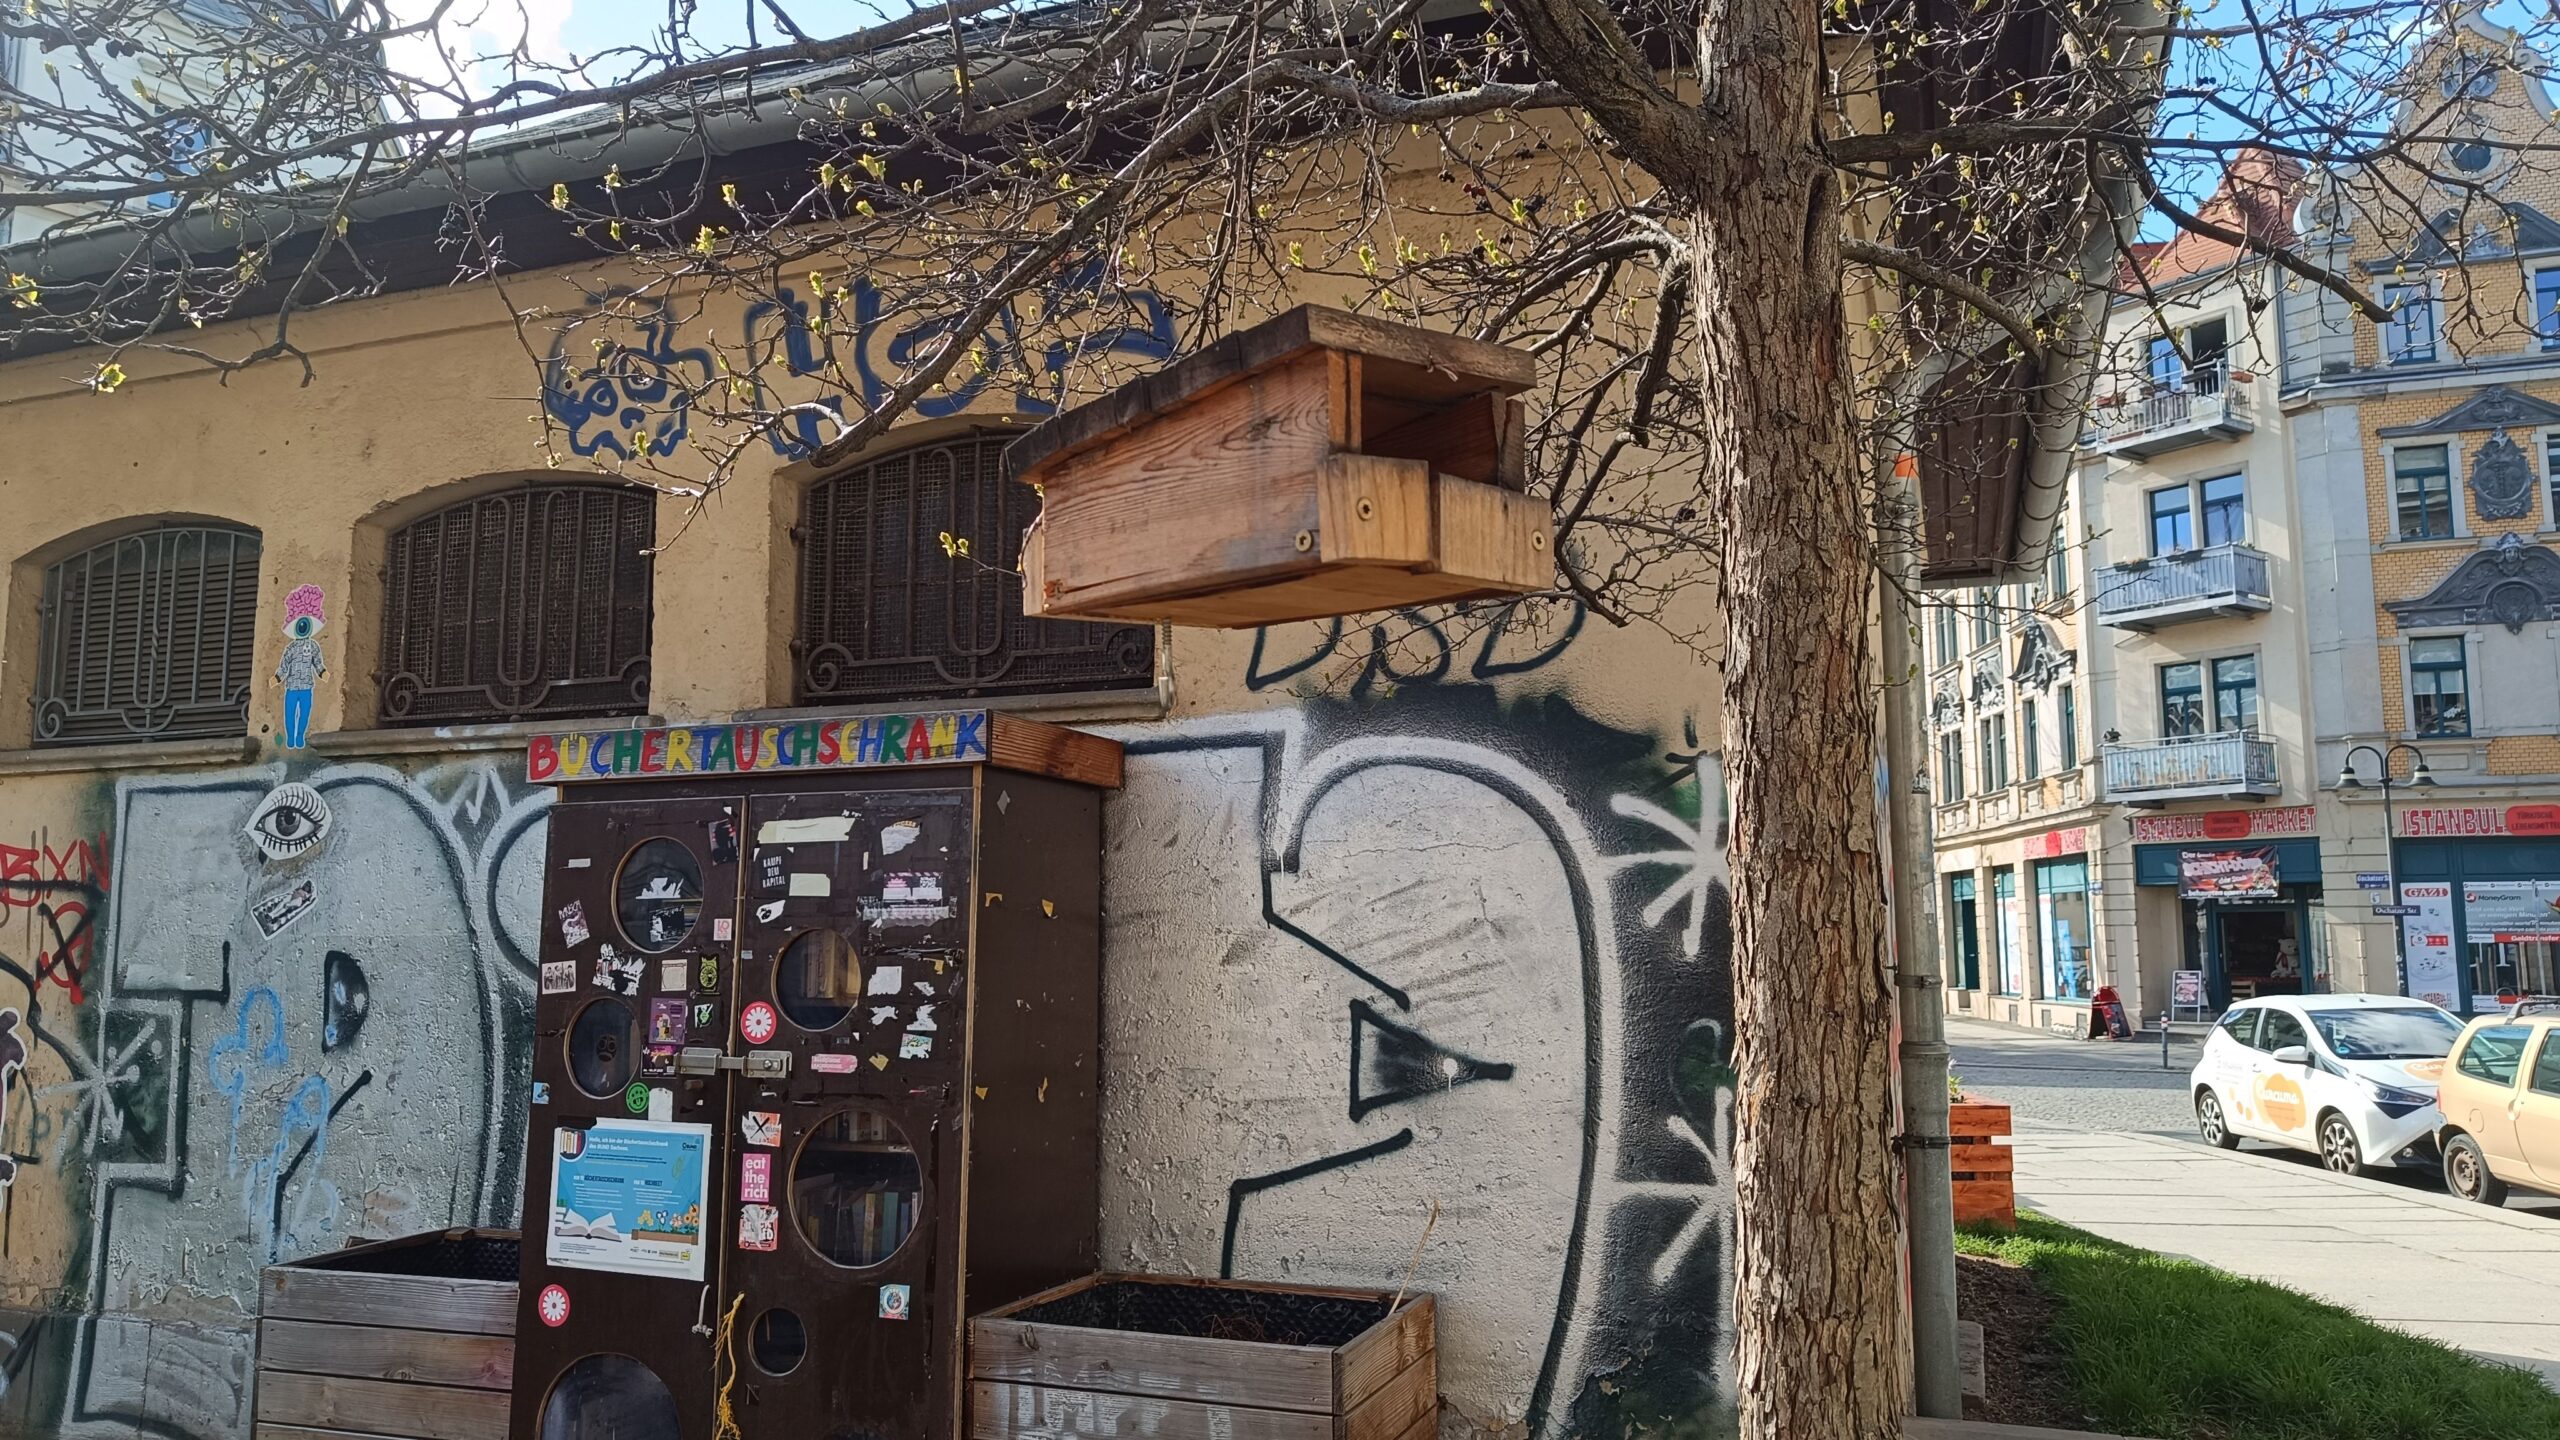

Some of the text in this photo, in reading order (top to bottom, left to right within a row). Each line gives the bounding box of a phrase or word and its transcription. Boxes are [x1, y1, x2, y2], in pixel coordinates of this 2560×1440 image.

[529, 711, 987, 781] BÜCHERTAUSCHSCHRANK
[2251, 806, 2316, 833] MARKET
[2402, 807, 2504, 836] ISTANBUL
[2135, 814, 2204, 841] ISTANBUL
[763, 855, 783, 868] KAMPF
[767, 866, 780, 878] DEM
[762, 876, 787, 889] KAPITAL
[2408, 888, 2446, 897] GAZI
[745, 1157, 767, 1169] eat
[744, 1170, 765, 1184] the
[744, 1184, 768, 1199] rich
